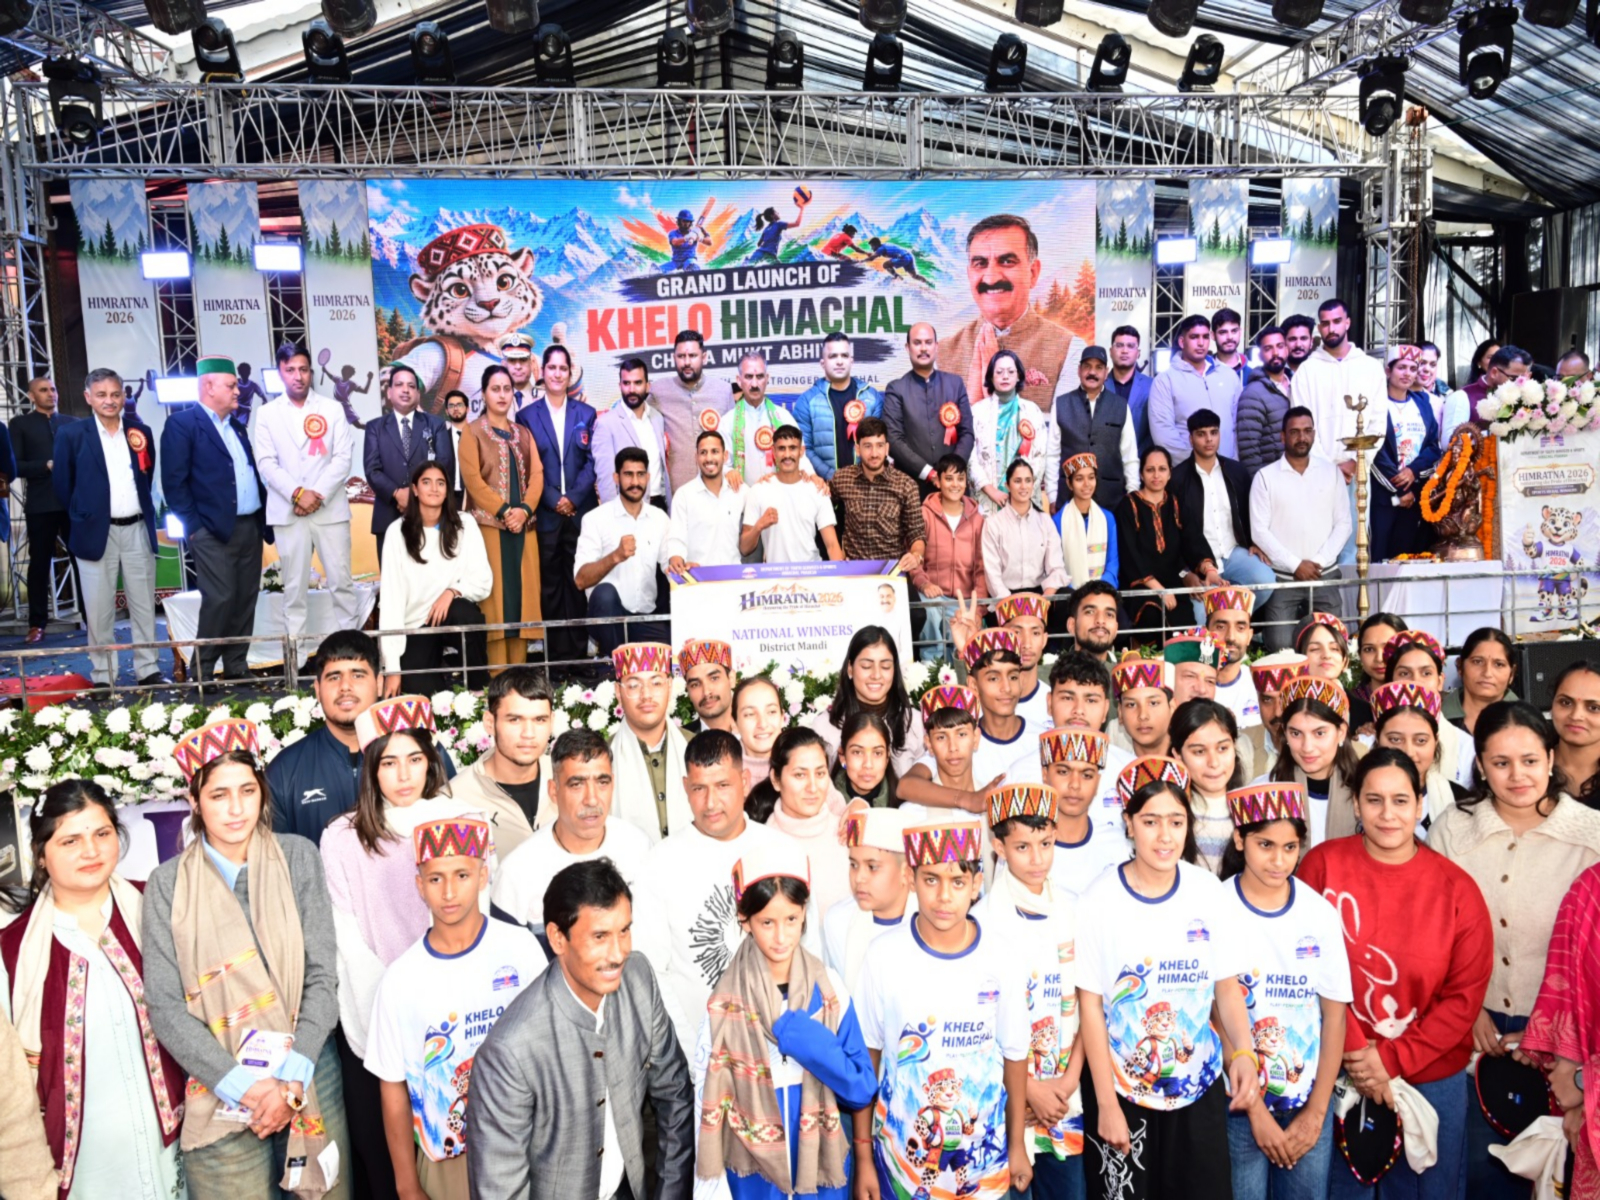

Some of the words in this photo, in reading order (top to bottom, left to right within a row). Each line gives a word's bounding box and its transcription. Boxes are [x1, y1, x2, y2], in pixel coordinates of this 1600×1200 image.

[657, 274, 726, 298] GRAND
[733, 266, 811, 291] LAUNCH
[817, 264, 841, 284] OF
[1285, 276, 1332, 287] HIMRATNA
[1099, 287, 1147, 299] HIMRATNA
[1192, 285, 1241, 297] HIMRATNA
[1297, 289, 1319, 300] 2026
[88, 297, 149, 310] HIMRATNA
[203, 298, 260, 311] HIMRATNA
[313, 294, 370, 307] HIMRATNA
[1111, 301, 1134, 312] 2026
[1205, 299, 1228, 309] 2026
[106, 312, 134, 324] 2026
[219, 314, 247, 325] 2026
[329, 309, 356, 321] 2026
[587, 302, 712, 352] KHELO
[720, 295, 912, 340] HIMACHAL
[1518, 470, 1565, 482] HIMRATNA
[1567, 469, 1589, 478] 2026
[1545, 550, 1570, 558] HIMRATNA
[1549, 557, 1567, 566] 2026
[732, 627, 794, 640] NATIONAL
[797, 624, 854, 637] WINNERS
[760, 643, 795, 653] District
[798, 640, 827, 650] Mandi
[1159, 958, 1199, 971] KHELO
[1266, 973, 1308, 985] KHELO
[465, 1005, 505, 1025] KHELO
[943, 1021, 984, 1033] KHELO
